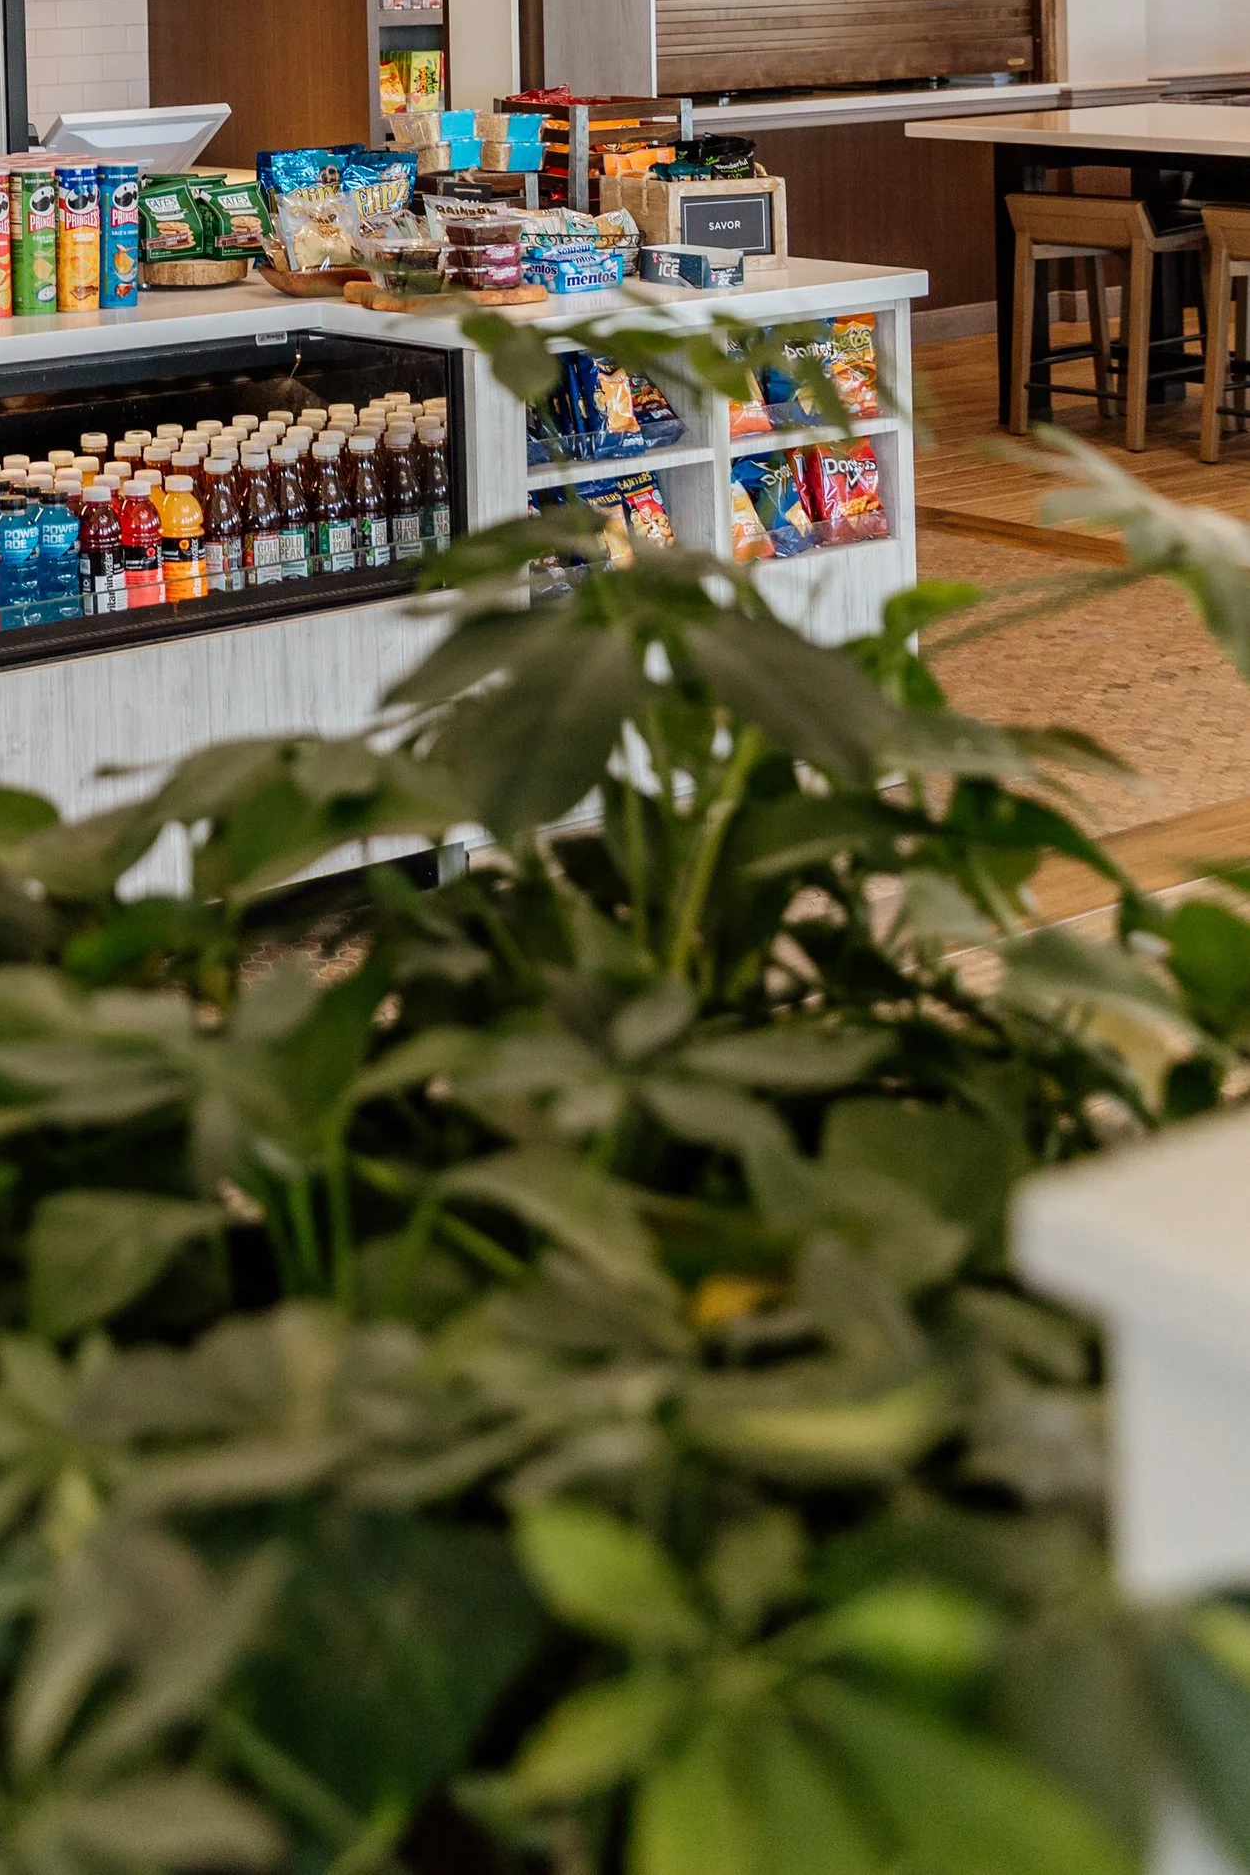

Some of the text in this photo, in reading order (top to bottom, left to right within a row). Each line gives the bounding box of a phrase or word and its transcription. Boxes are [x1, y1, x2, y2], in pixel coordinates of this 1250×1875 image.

[149, 196, 177, 207] TATE'S
[221, 193, 249, 205] TATE'S
[354, 179, 410, 220] Flipz
[435, 205, 498, 216] RAINBOW
[66, 206, 99, 229] PRINGLES
[709, 220, 741, 231] SAVOR
[658, 263, 681, 279] ICE
[566, 271, 618, 287] mentos
[823, 457, 877, 475] Doritos
[4, 527, 39, 539] POWER
[42, 523, 79, 534] POWER
[4, 539, 28, 549] ADE
[42, 534, 65, 543] ADE
[279, 536, 302, 547] GOLD
[279, 548, 302, 559] PEAK
